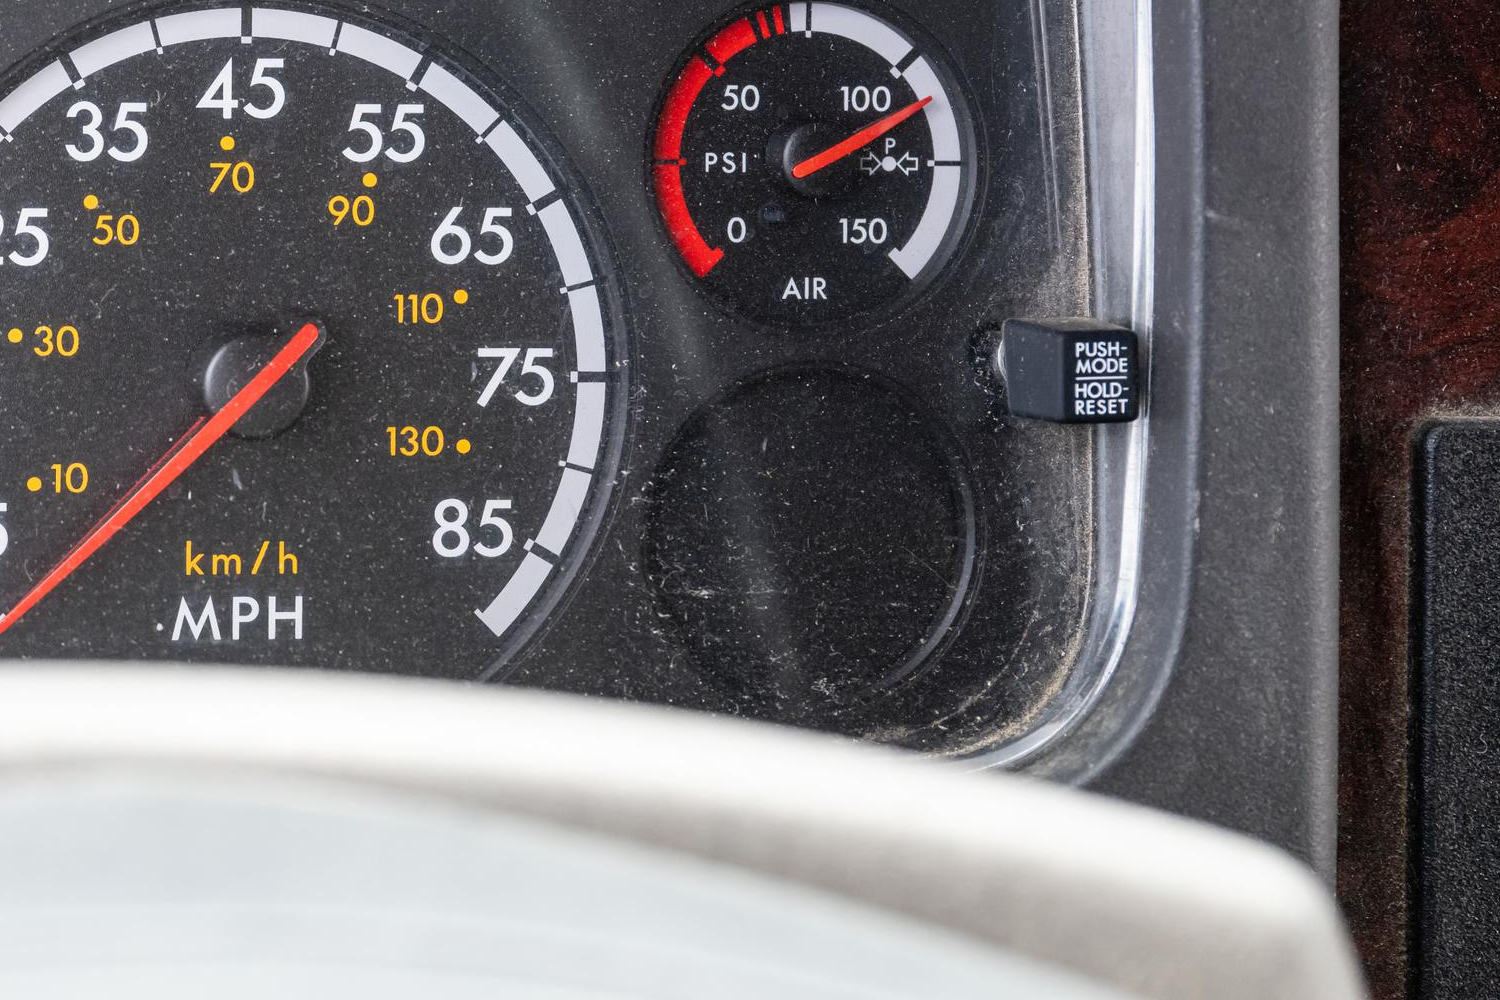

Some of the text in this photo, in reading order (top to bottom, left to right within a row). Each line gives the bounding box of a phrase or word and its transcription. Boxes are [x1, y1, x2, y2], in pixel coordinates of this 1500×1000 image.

[195, 56, 286, 120] 45
[721, 84, 760, 112] 50
[840, 85, 892, 113] 100
[64, 100, 149, 163] 35
[341, 103, 426, 164] 55
[209, 161, 255, 194] 70
[705, 151, 747, 174] PSI
[328, 195, 375, 226] 90
[92, 214, 140, 246] 50
[430, 206, 514, 266] 65
[726, 216, 747, 244] 0
[838, 217, 888, 245] 150
[781, 276, 828, 300] AIR
[393, 293, 444, 324] 110
[33, 325, 80, 357] 30
[1075, 341, 1128, 358] PUSH-
[476, 345, 555, 408] 75
[1075, 357, 1128, 374] MODE
[1074, 381, 1130, 399] HOLD-
[1074, 398, 1129, 416] RESET
[386, 425, 445, 457] 130
[50, 462, 89, 494] 10
[432, 497, 514, 558] 85
[185, 540, 298, 576] km/h
[171, 595, 303, 641] MPH
